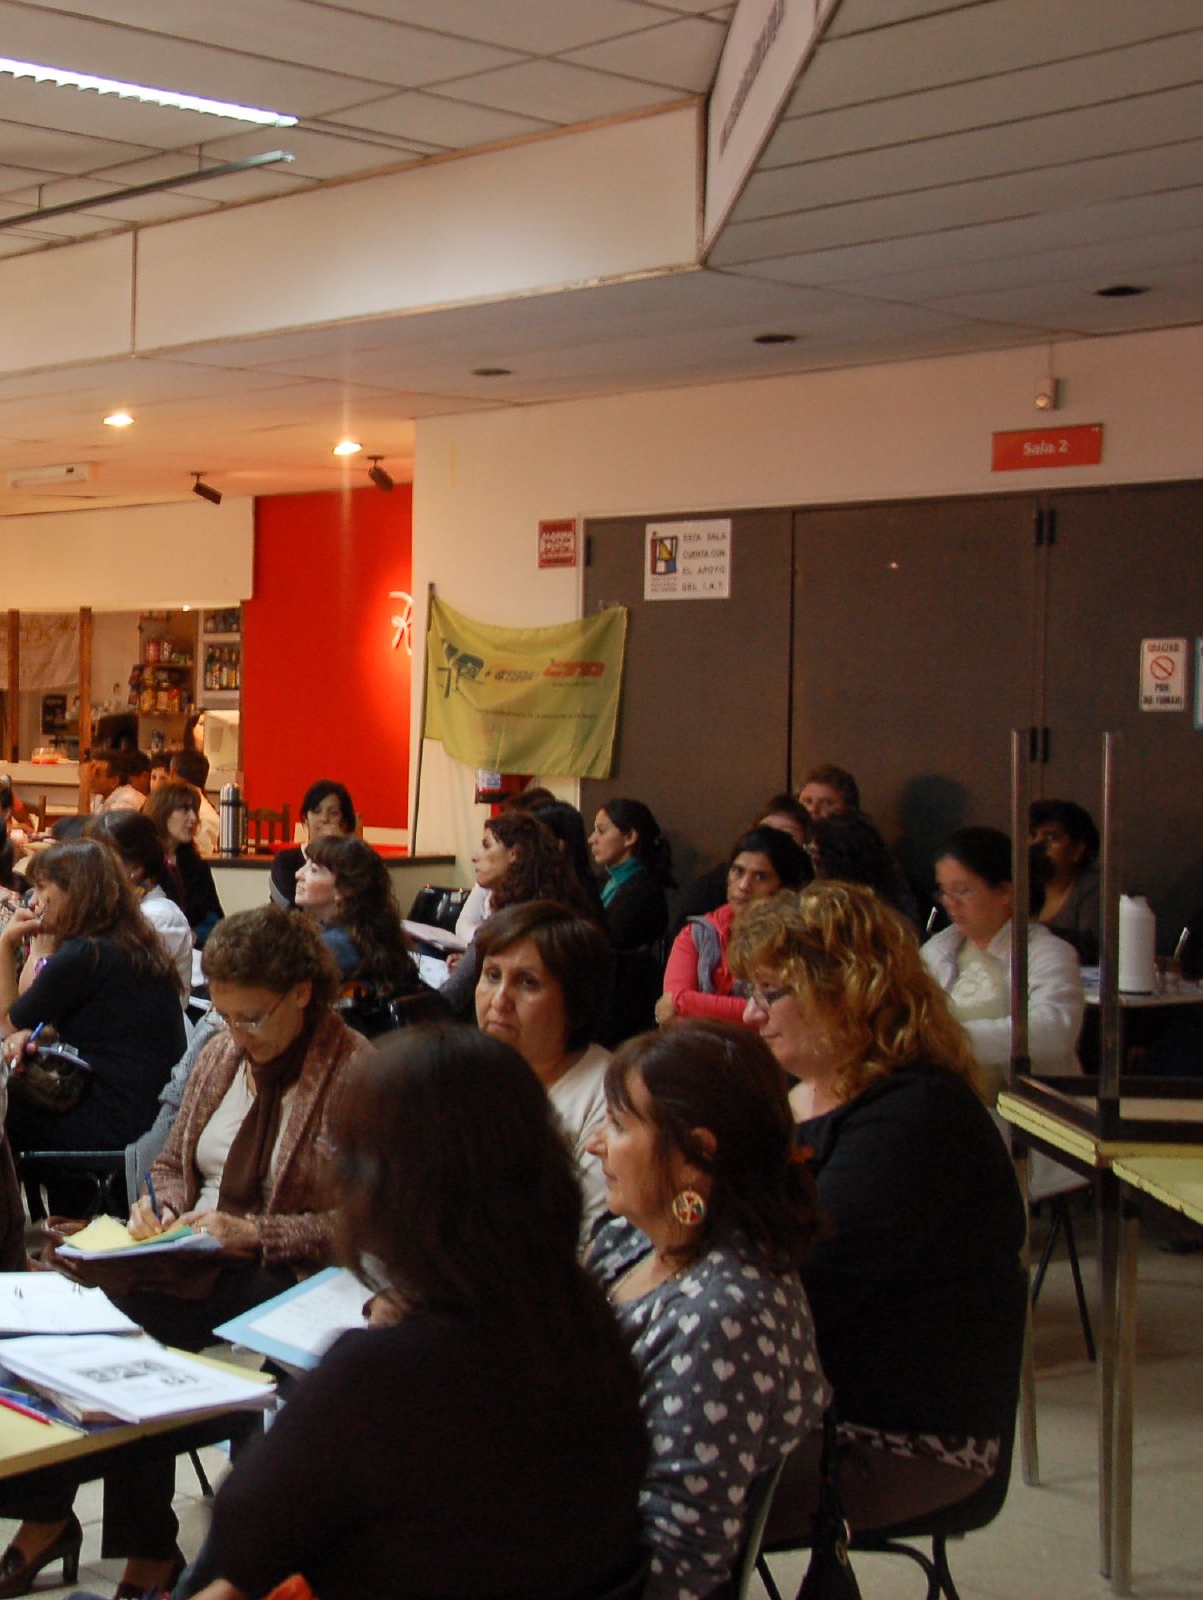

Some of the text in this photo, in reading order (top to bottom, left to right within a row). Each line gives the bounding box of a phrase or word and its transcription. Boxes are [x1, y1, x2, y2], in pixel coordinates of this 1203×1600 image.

[1023, 439, 1069, 456] Sala 2
[682, 531, 726, 542] ESTA SALA
[682, 548, 725, 560] CUENTA CON
[681, 565, 725, 576] EL APOYO
[681, 582, 697, 593] DEL
[1143, 695, 1153, 705] NO
